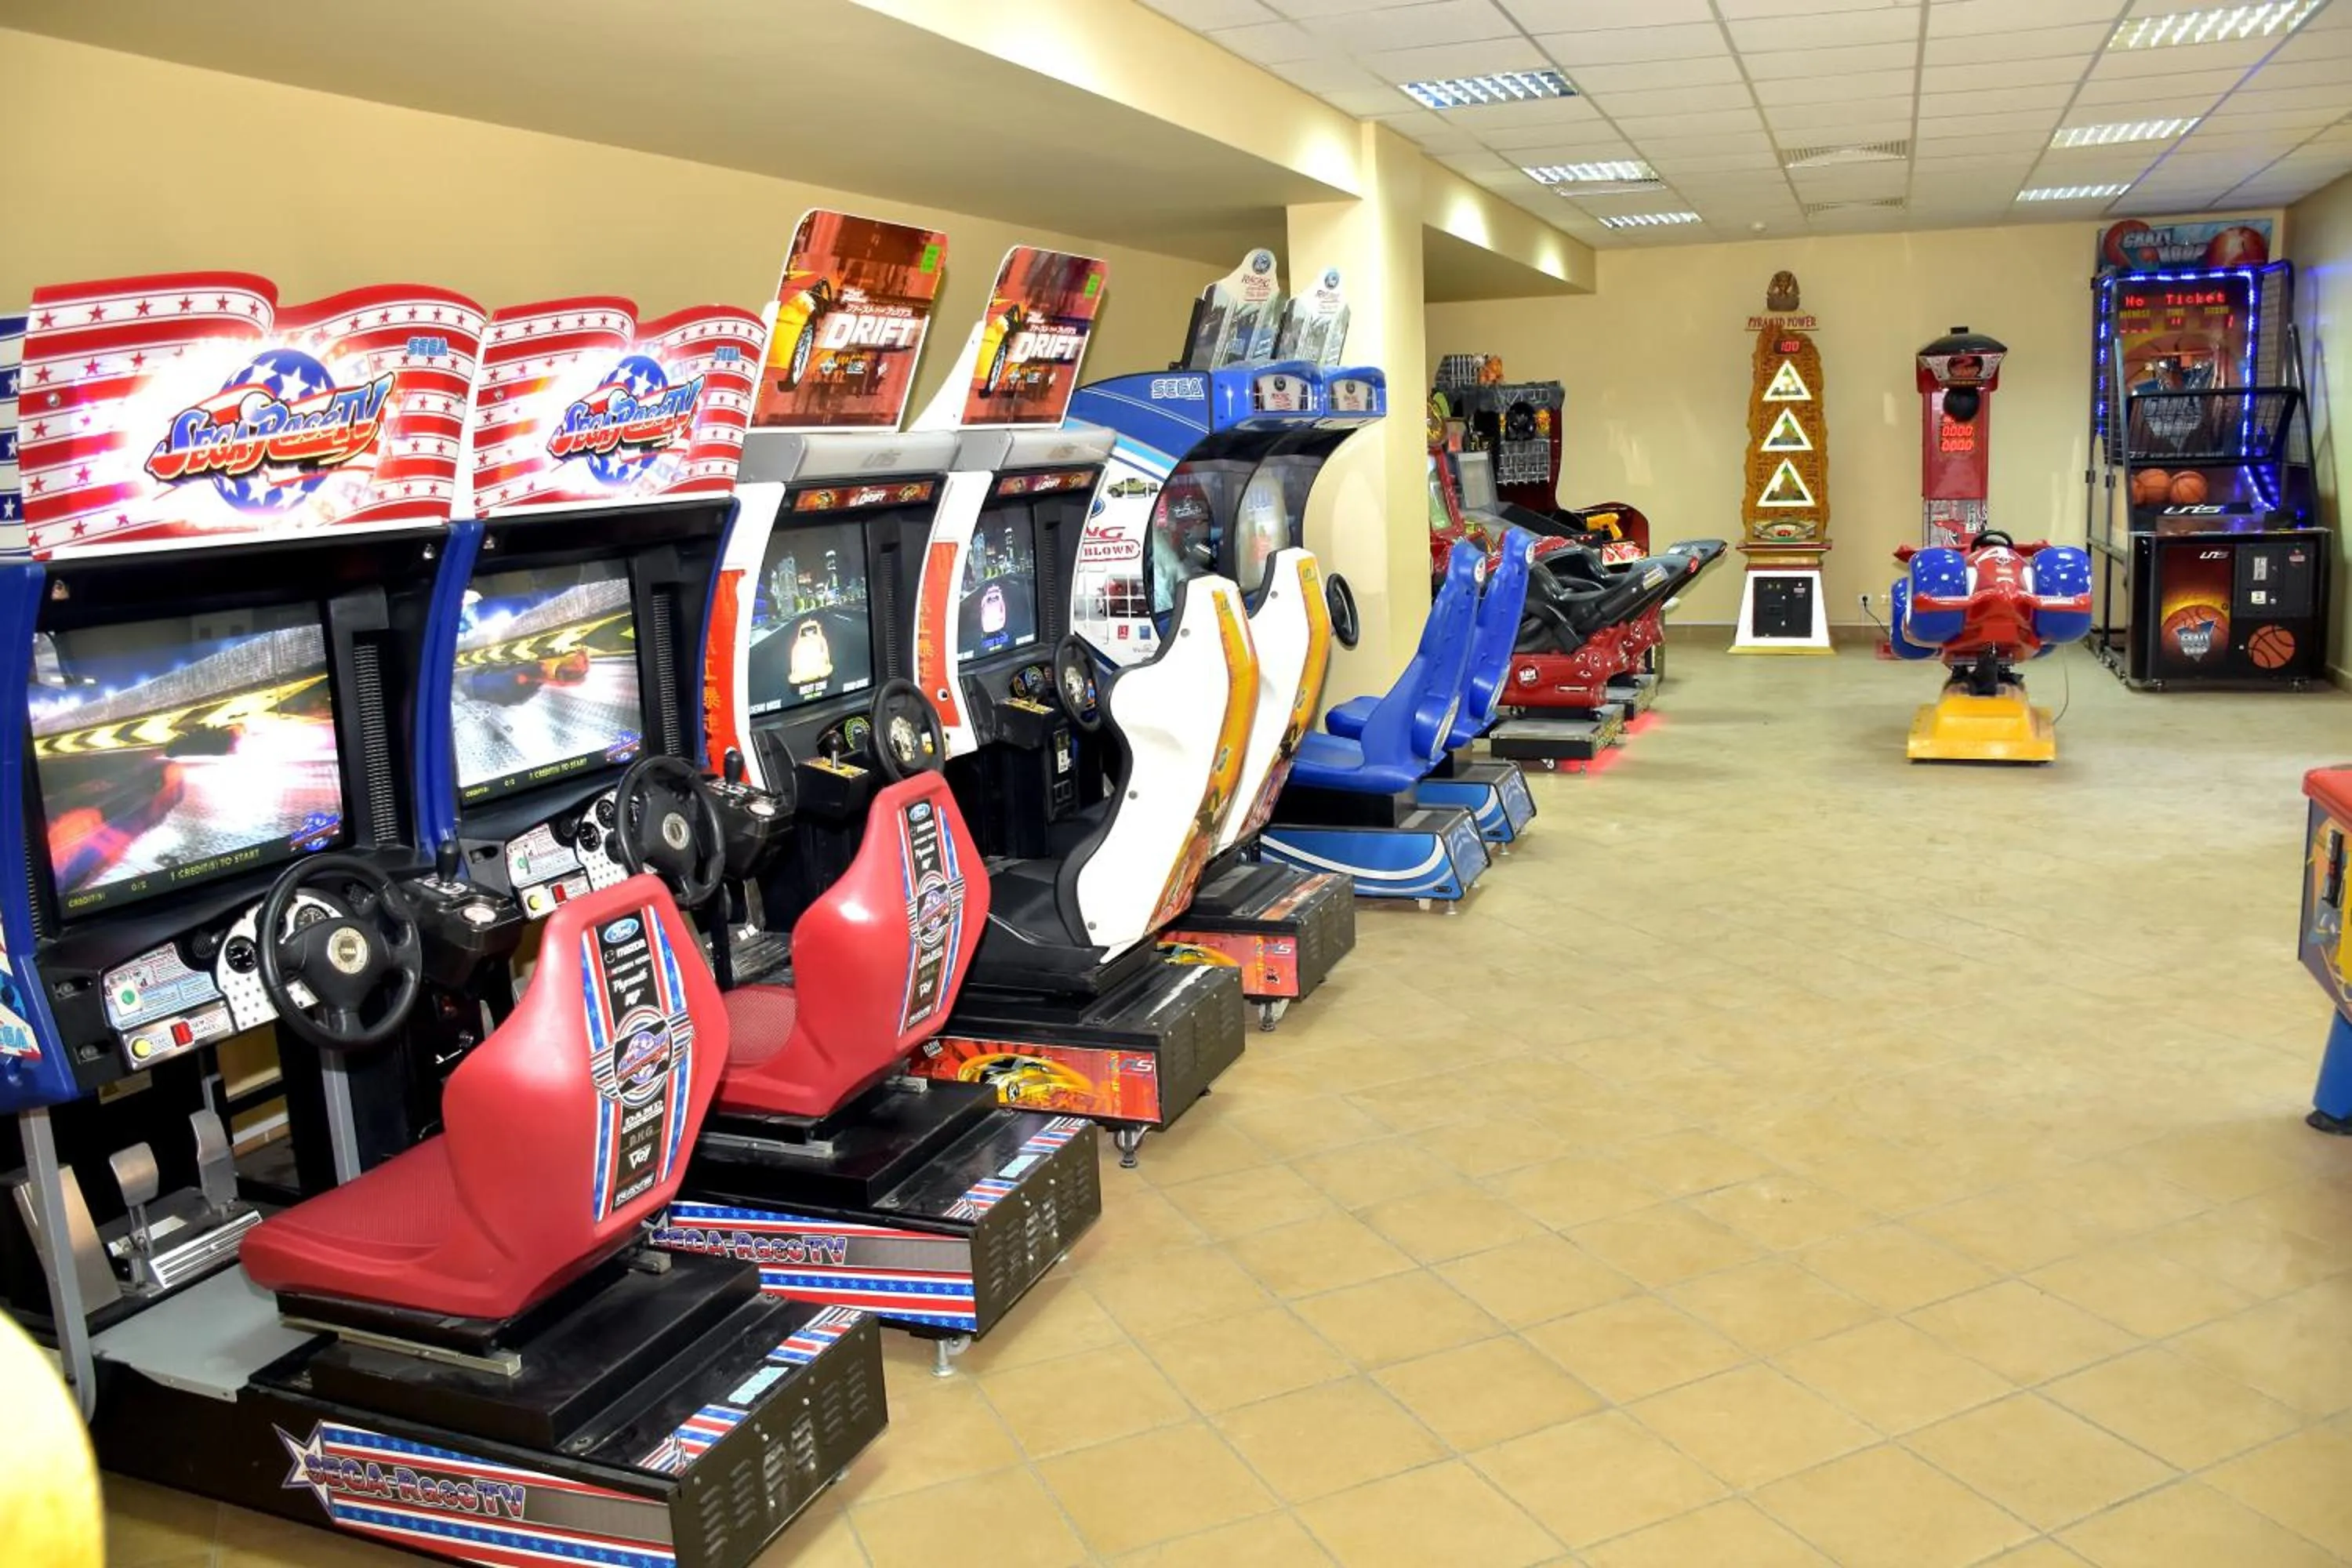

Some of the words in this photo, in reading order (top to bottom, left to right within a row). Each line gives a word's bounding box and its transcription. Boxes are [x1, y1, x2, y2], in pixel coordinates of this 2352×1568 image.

[2166, 292, 2225, 305] Ticket
[823, 313, 916, 350] DRIFT
[1788, 316, 1817, 327] POWER
[407, 337, 448, 357] SEGA
[1009, 332, 1081, 363] DRIFT
[1151, 378, 1205, 400] SEGA
[1084, 544, 1135, 557] BLOWN
[220, 858, 231, 868] TO
[234, 848, 260, 863] START
